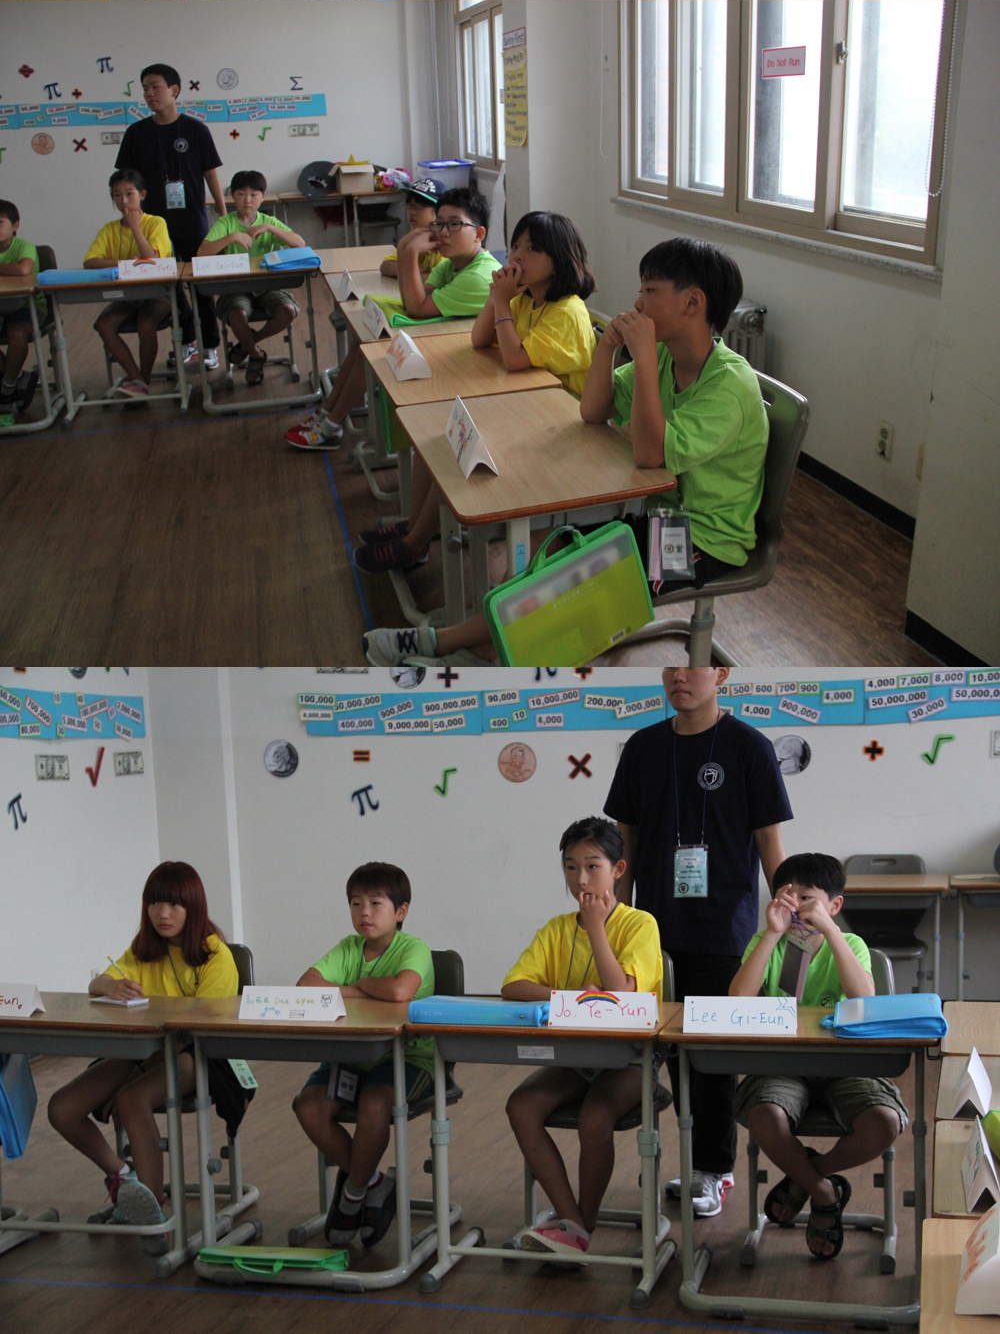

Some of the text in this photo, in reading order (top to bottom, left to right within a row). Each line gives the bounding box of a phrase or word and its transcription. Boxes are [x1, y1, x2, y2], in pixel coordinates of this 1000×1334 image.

[766, 57, 800, 68] Do Not Run
[867, 678, 895, 689] 4,000
[901, 675, 929, 686] 7,000
[934, 672, 963, 683] 8,000
[733, 684, 750, 694] 500
[755, 684, 773, 693] 600
[779, 683, 796, 693] 700
[800, 683, 818, 692] 900
[300, 694, 334, 705] 100,000
[487, 692, 517, 703] 90,000
[531, 689, 578, 707] 10,000,000
[824, 691, 852, 702] 4,000
[871, 690, 926, 707] 50,000,000
[380, 699, 412, 719] 900,000
[424, 697, 476, 713] 900,000,000
[617, 697, 661, 716] 7,000,000
[744, 705, 770, 716] 4,000
[780, 699, 818, 720] 900,000
[911, 698, 945, 719] 30,000
[514, 710, 525, 721] 10
[537, 715, 562, 725] 4,000
[340, 719, 373, 729] 400,000
[387, 720, 430, 731] 9,000,000
[434, 717, 464, 730] 50,000
[491, 718, 507, 727] 400
[582, 999, 647, 1019] Ye-Yun
[691, 1006, 718, 1023] Lee
